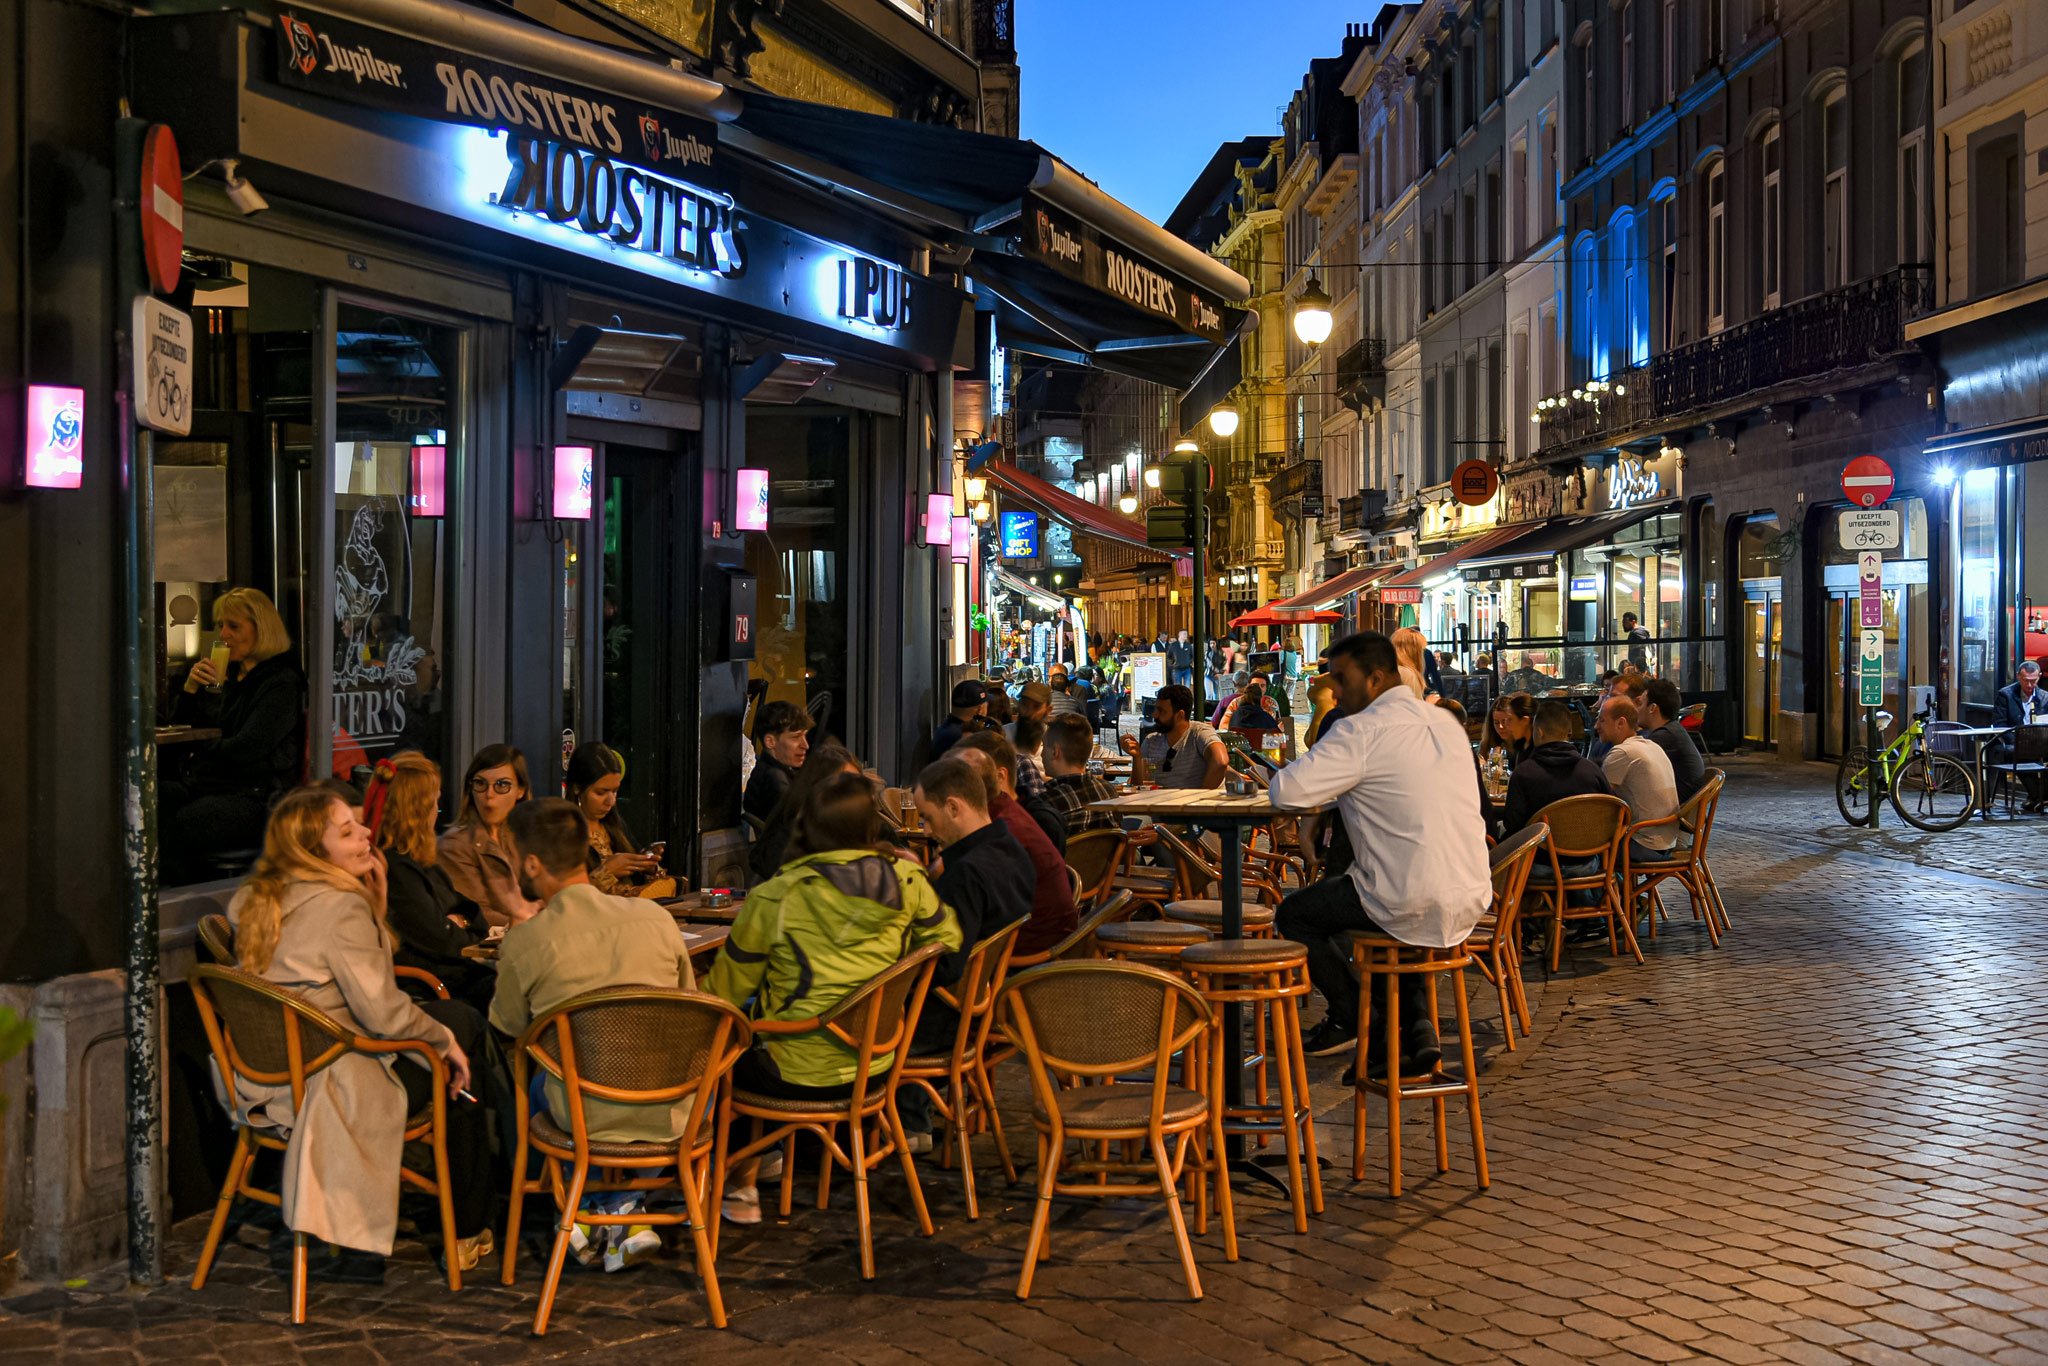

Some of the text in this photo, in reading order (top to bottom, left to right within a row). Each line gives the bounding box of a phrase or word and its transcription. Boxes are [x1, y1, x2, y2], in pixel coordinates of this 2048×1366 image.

[317, 32, 403, 88] Jupiler
[436, 62, 623, 154] ROOSTER'S
[662, 126, 714, 167] Jupiler
[1049, 222, 1082, 263] Jupiler
[1106, 249, 1177, 318] ROOSTER'S
[712, 521, 721, 539] 79
[1008, 538, 1030, 548] GIFT
[1848, 520, 1891, 528] UITGEZONDERD
[1005, 547, 1033, 556] SHOP
[737, 617, 749, 641] 79
[332, 688, 407, 737] TER'S
